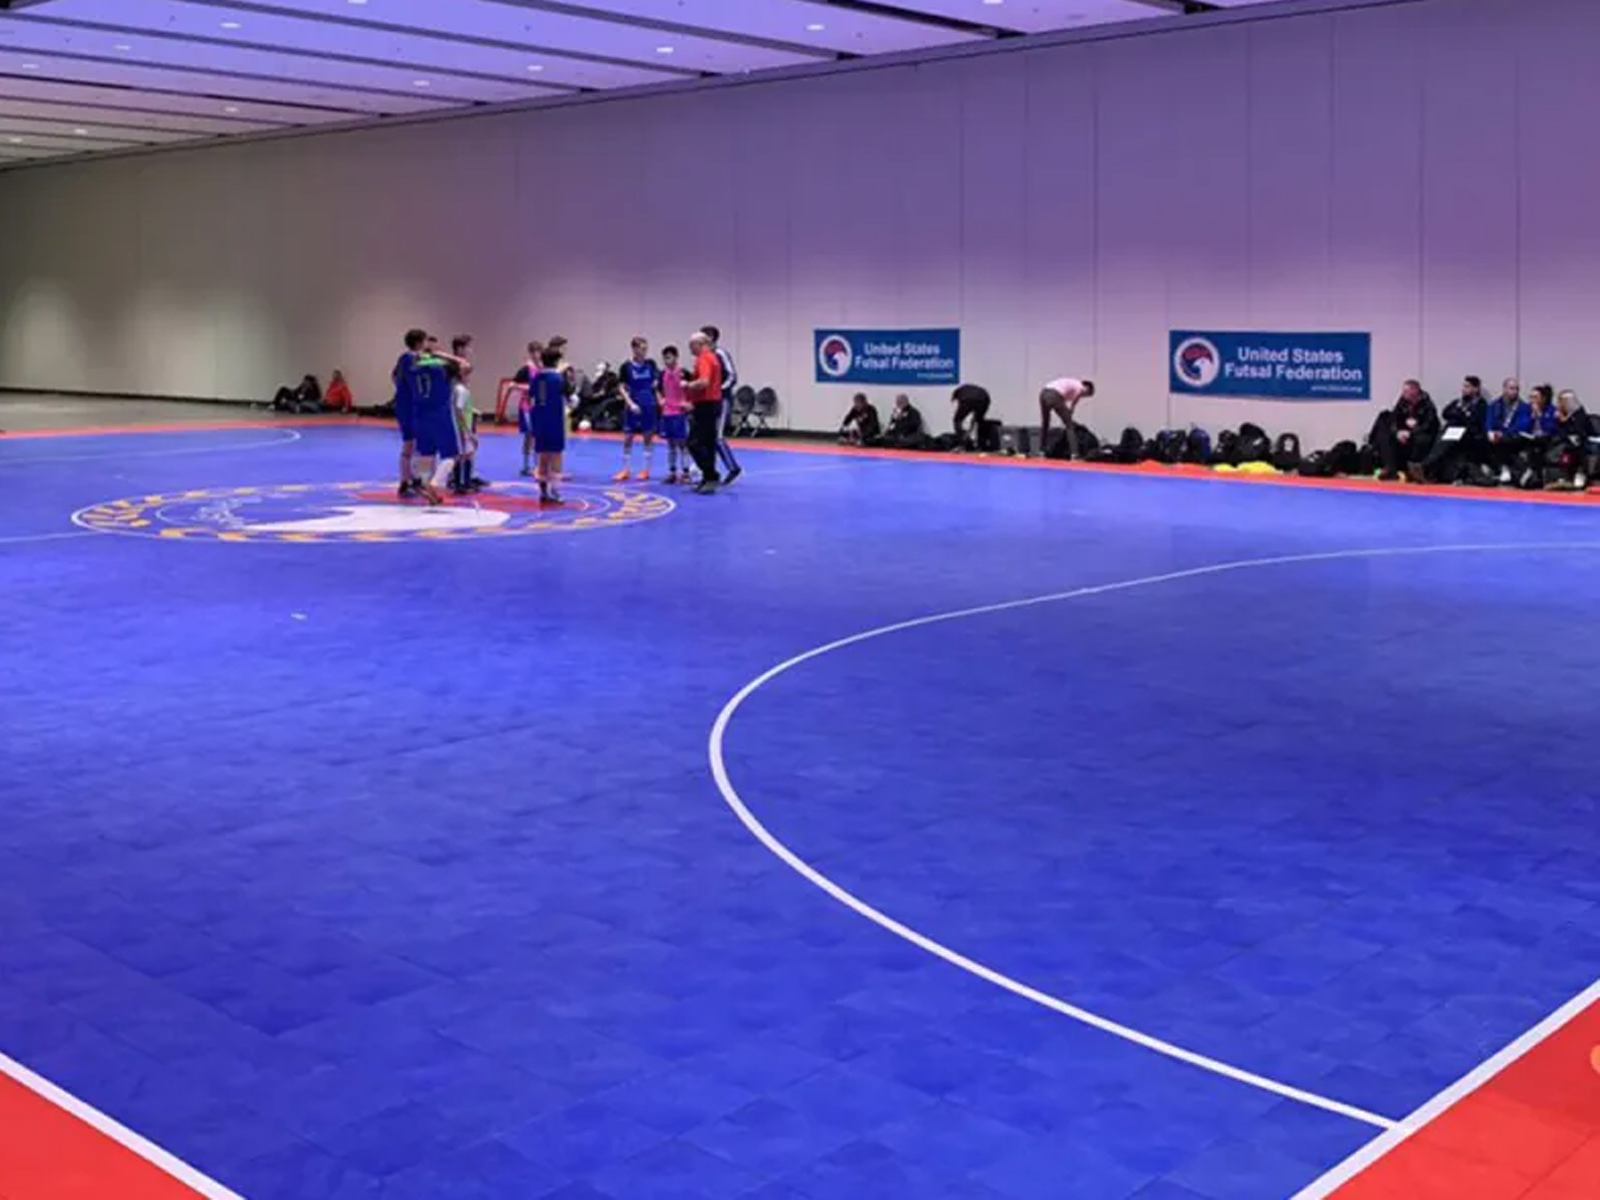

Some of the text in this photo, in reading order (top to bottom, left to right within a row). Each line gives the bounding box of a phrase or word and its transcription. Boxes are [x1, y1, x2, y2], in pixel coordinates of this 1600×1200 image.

[863, 342, 941, 355] United States
[1237, 346, 1344, 364] United States
[854, 356, 955, 370] Futsal Federation
[1224, 363, 1363, 380] Futsal Federation
